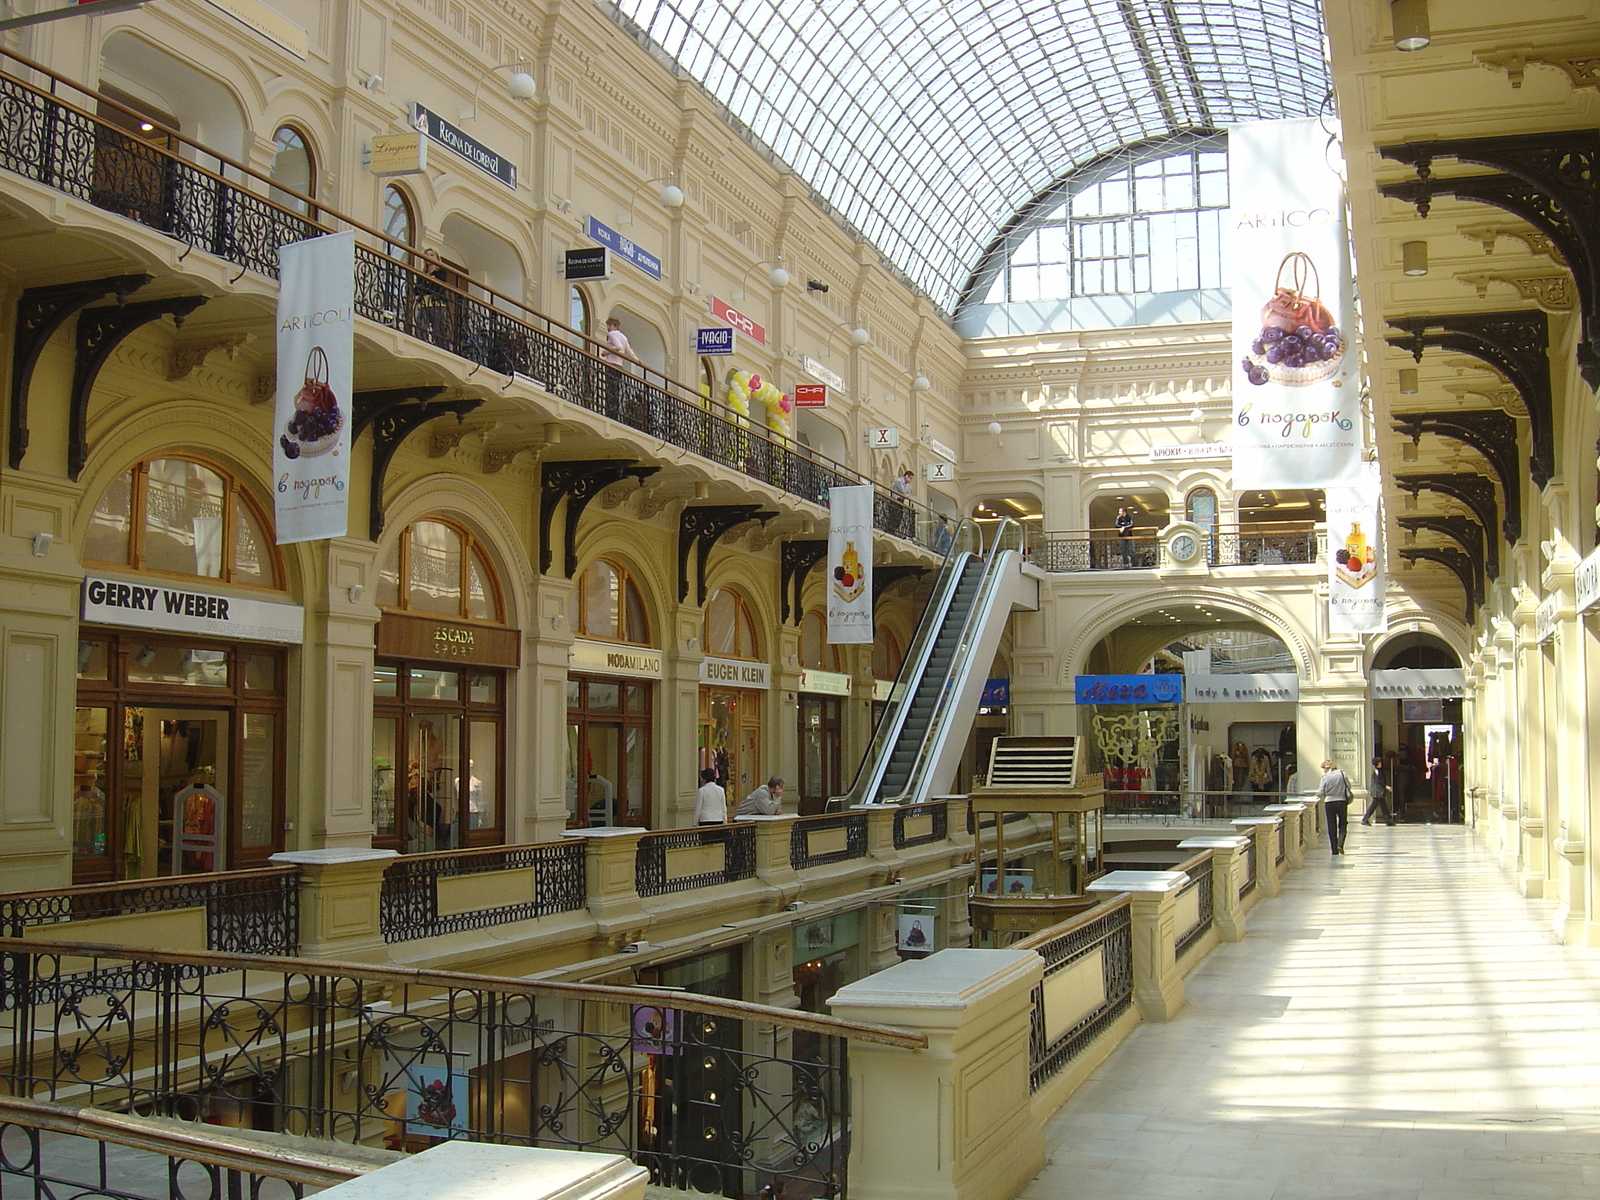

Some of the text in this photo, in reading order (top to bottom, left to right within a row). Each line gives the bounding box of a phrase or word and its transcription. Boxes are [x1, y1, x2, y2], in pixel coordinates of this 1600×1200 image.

[375, 140, 419, 156] Lingerie
[440, 120, 499, 174] REGINA DE LORENZI
[1237, 208, 1342, 230] ARTICOL
[597, 227, 611, 242] КОЖА
[637, 252, 659, 272] ДУБЛЕНКИ
[280, 307, 351, 333] ARTICOLI
[725, 308, 754, 336] CHR
[702, 330, 728, 345] IVAGIO
[1238, 402, 1353, 438] в подарок
[1153, 448, 1182, 457] БРЮКИ
[293, 474, 345, 500] подарок
[88, 580, 229, 621] GERRY WEBER
[434, 626, 475, 645] ESCADA
[434, 643, 474, 657] SPORT
[607, 653, 660, 672] MODAMILANO
[707, 662, 765, 684] EUGEN KLEIN
[1082, 680, 1147, 700] Меха
[1195, 687, 1291, 700] lady & gentleman
